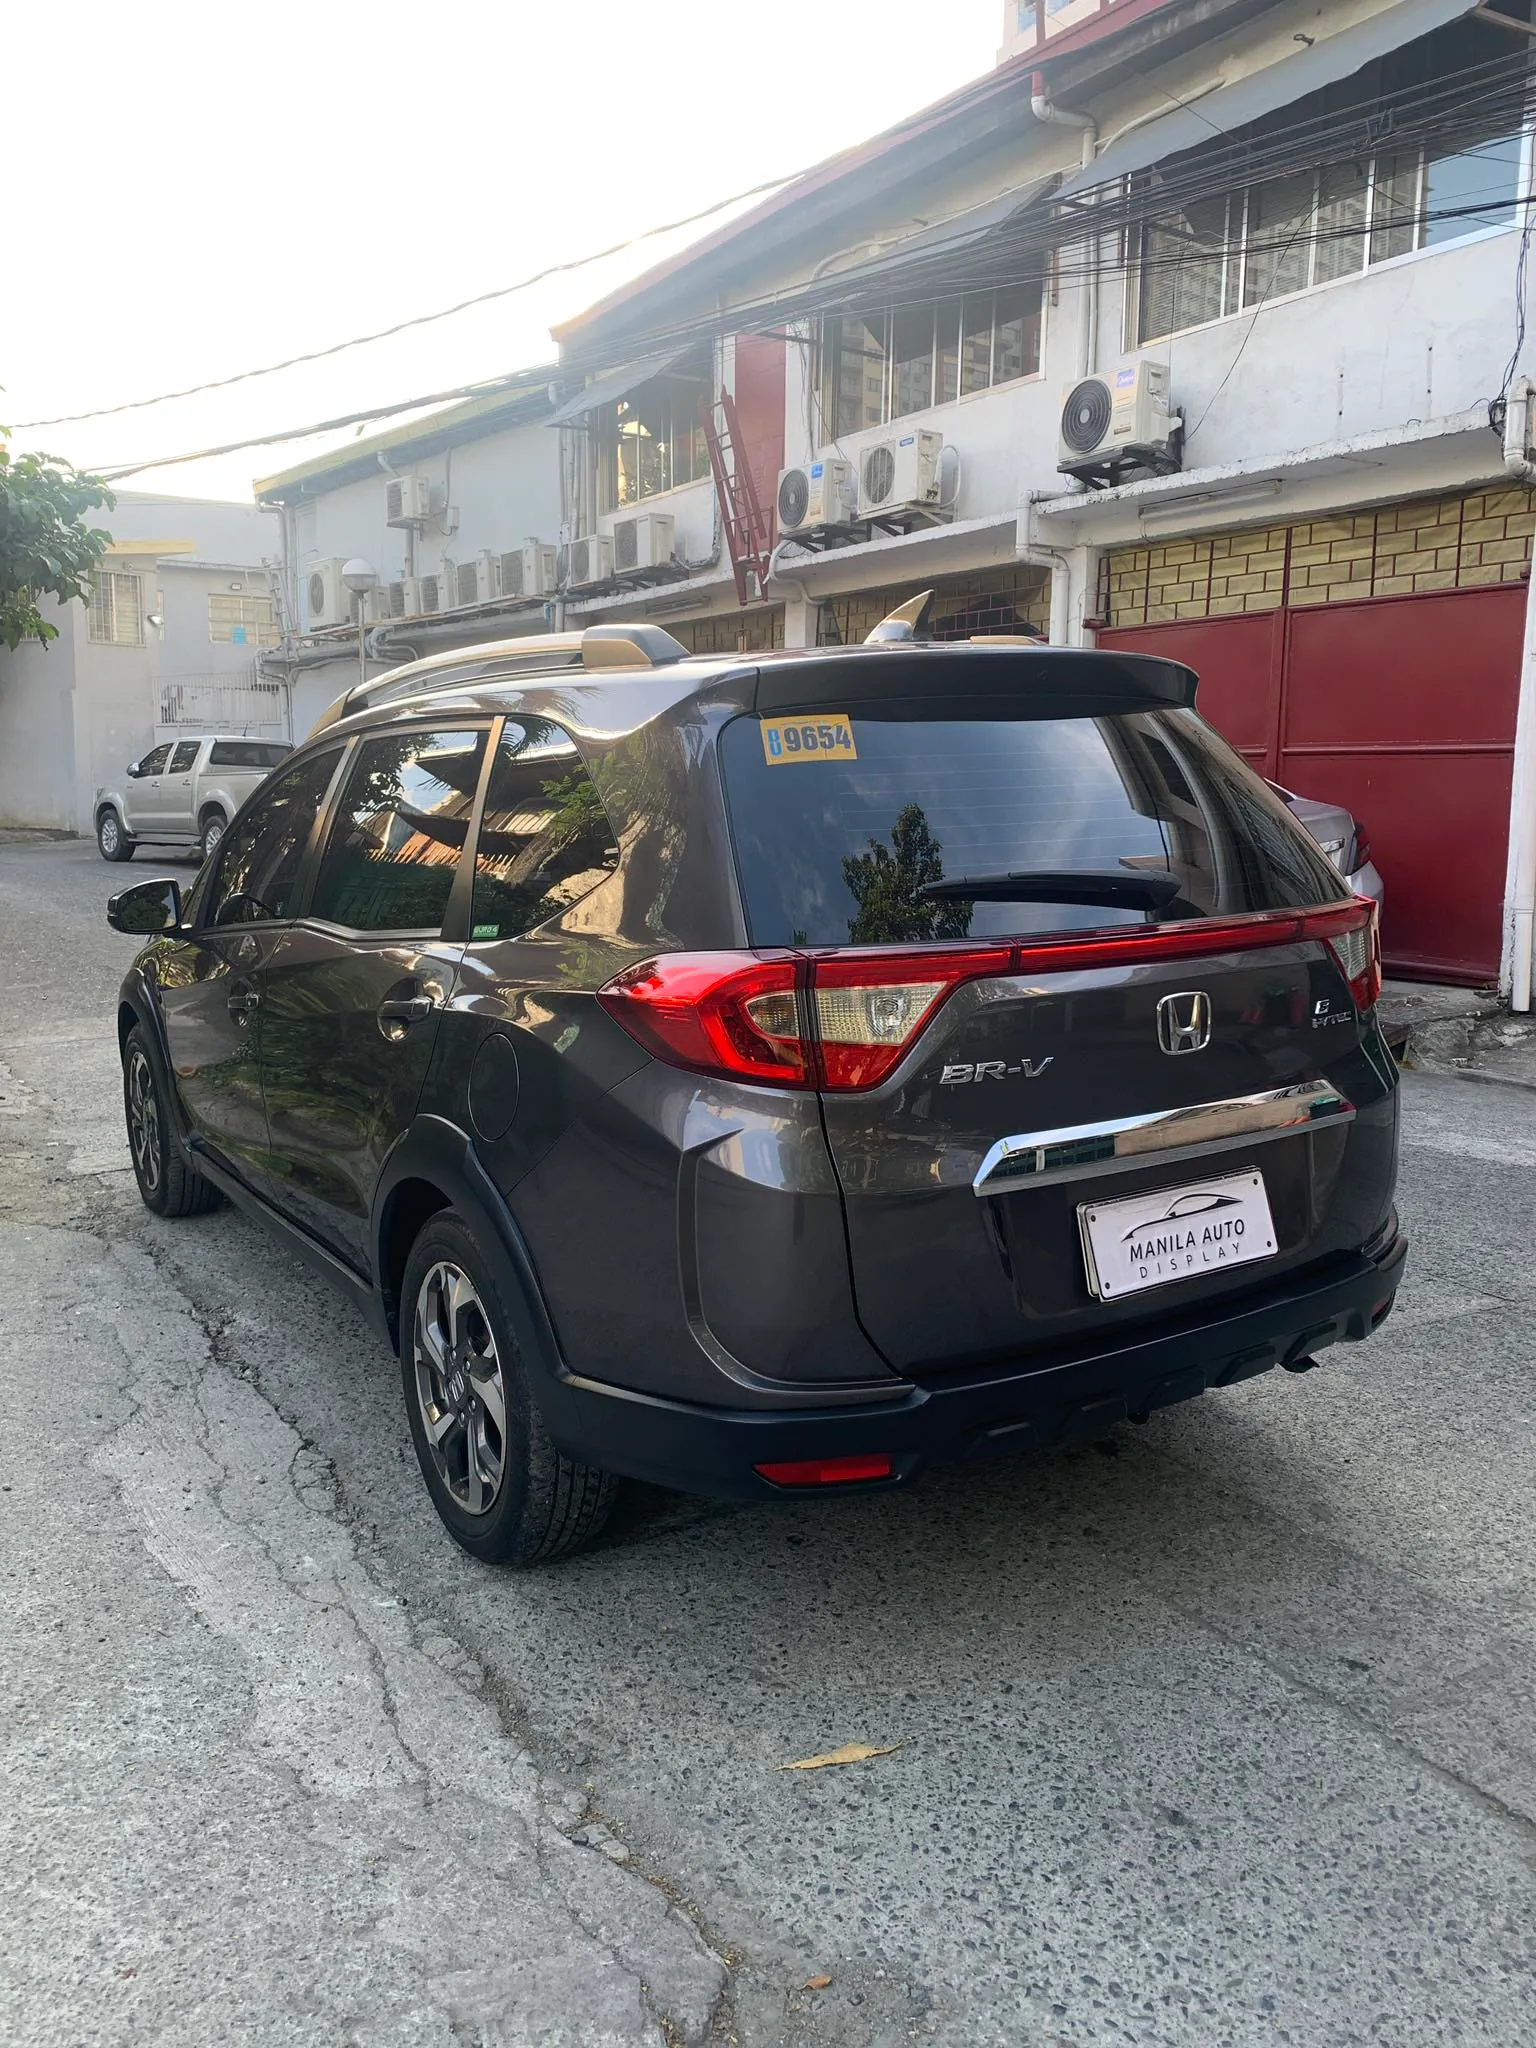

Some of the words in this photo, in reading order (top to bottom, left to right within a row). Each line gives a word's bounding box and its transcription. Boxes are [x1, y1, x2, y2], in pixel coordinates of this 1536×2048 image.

[783, 725, 852, 752] 9654
[940, 1056, 1054, 1085] BR-V
[1129, 1231, 1196, 1262] MANILA
[1202, 1218, 1245, 1244] AUTO
[1139, 1242, 1241, 1279] DISPLAY
